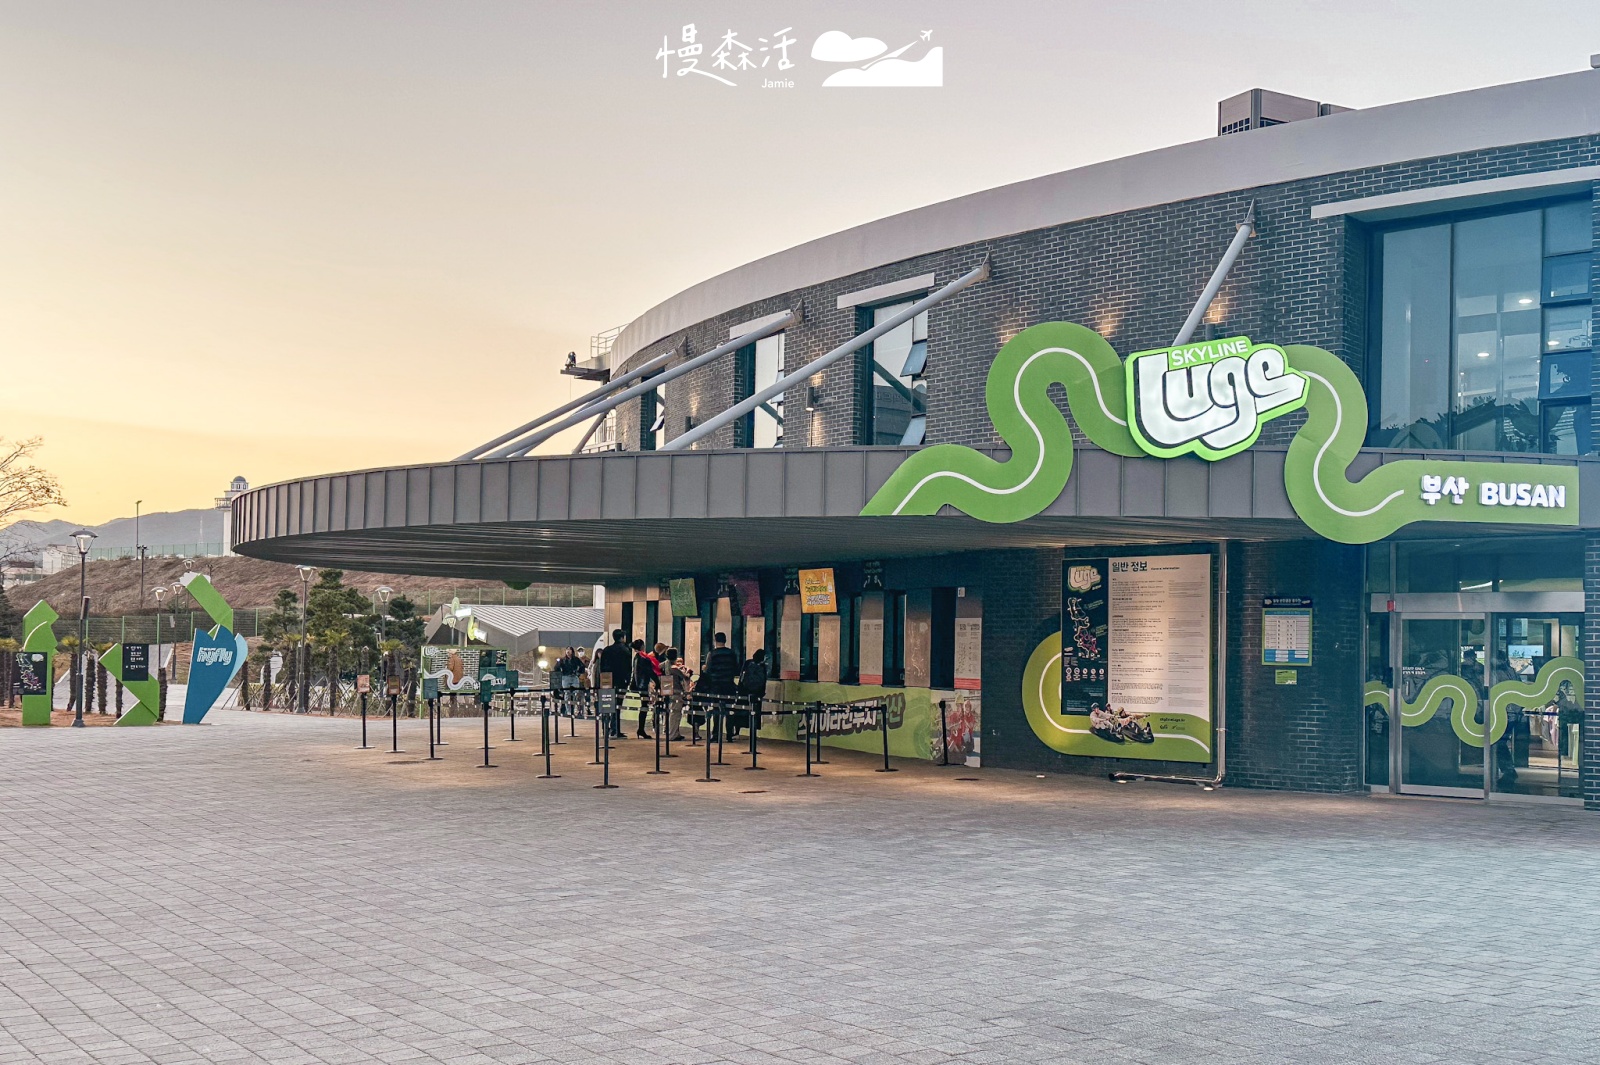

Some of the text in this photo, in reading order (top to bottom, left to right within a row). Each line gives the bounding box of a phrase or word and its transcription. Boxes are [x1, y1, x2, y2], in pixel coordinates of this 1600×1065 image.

[1171, 339, 1249, 367] SKYLINE
[1421, 474, 1566, 508] 부산 BUSAN
[1112, 560, 1148, 573] 일반 정보
